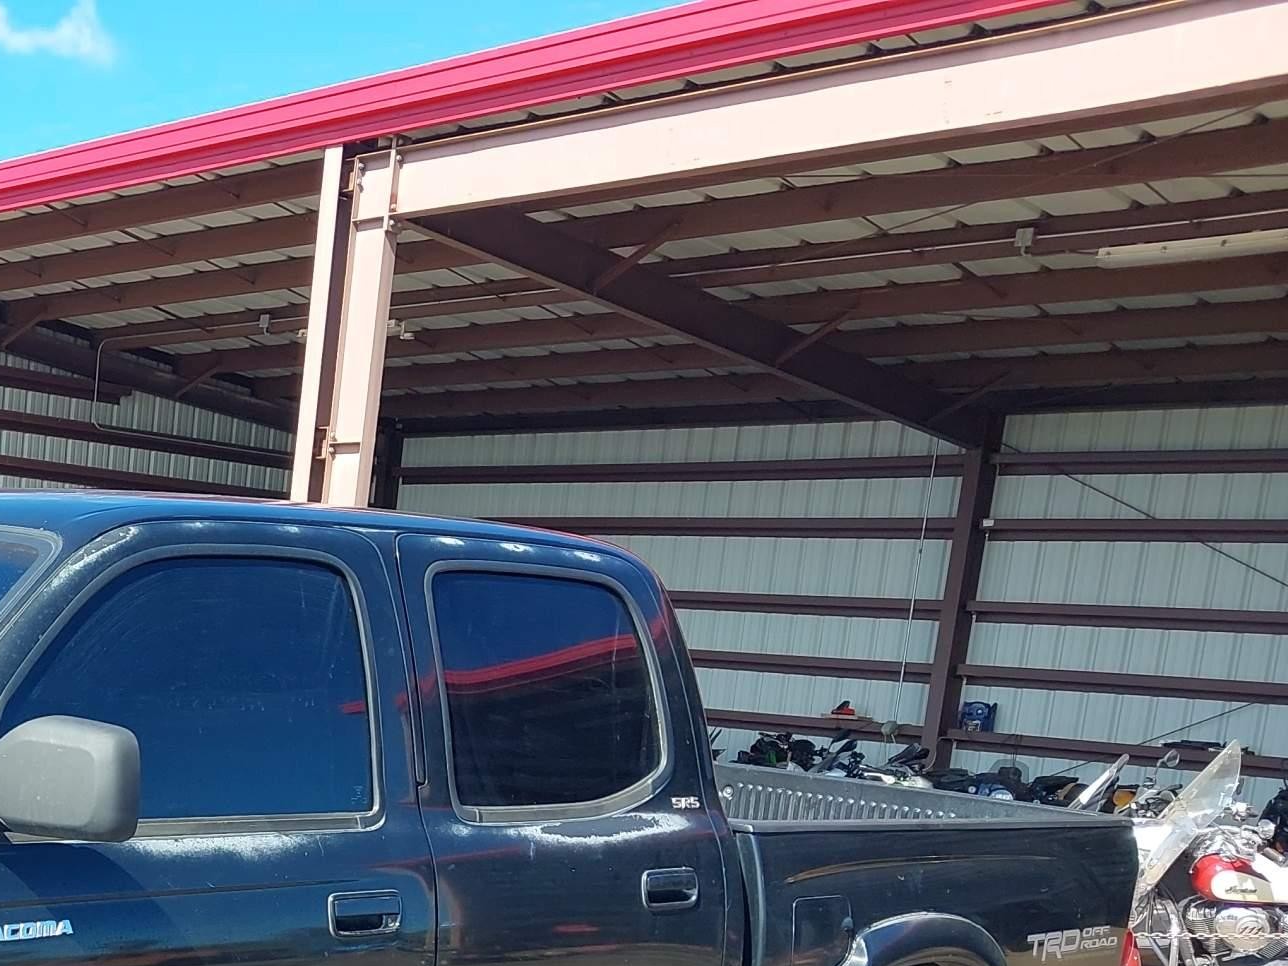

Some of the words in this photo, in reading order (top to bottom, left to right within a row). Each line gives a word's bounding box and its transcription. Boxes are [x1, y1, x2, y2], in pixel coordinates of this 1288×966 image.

[671, 796, 701, 809] SR5
[1082, 925, 1111, 937] OFF
[1027, 928, 1081, 962] TRD
[1080, 936, 1118, 949] ROAD
